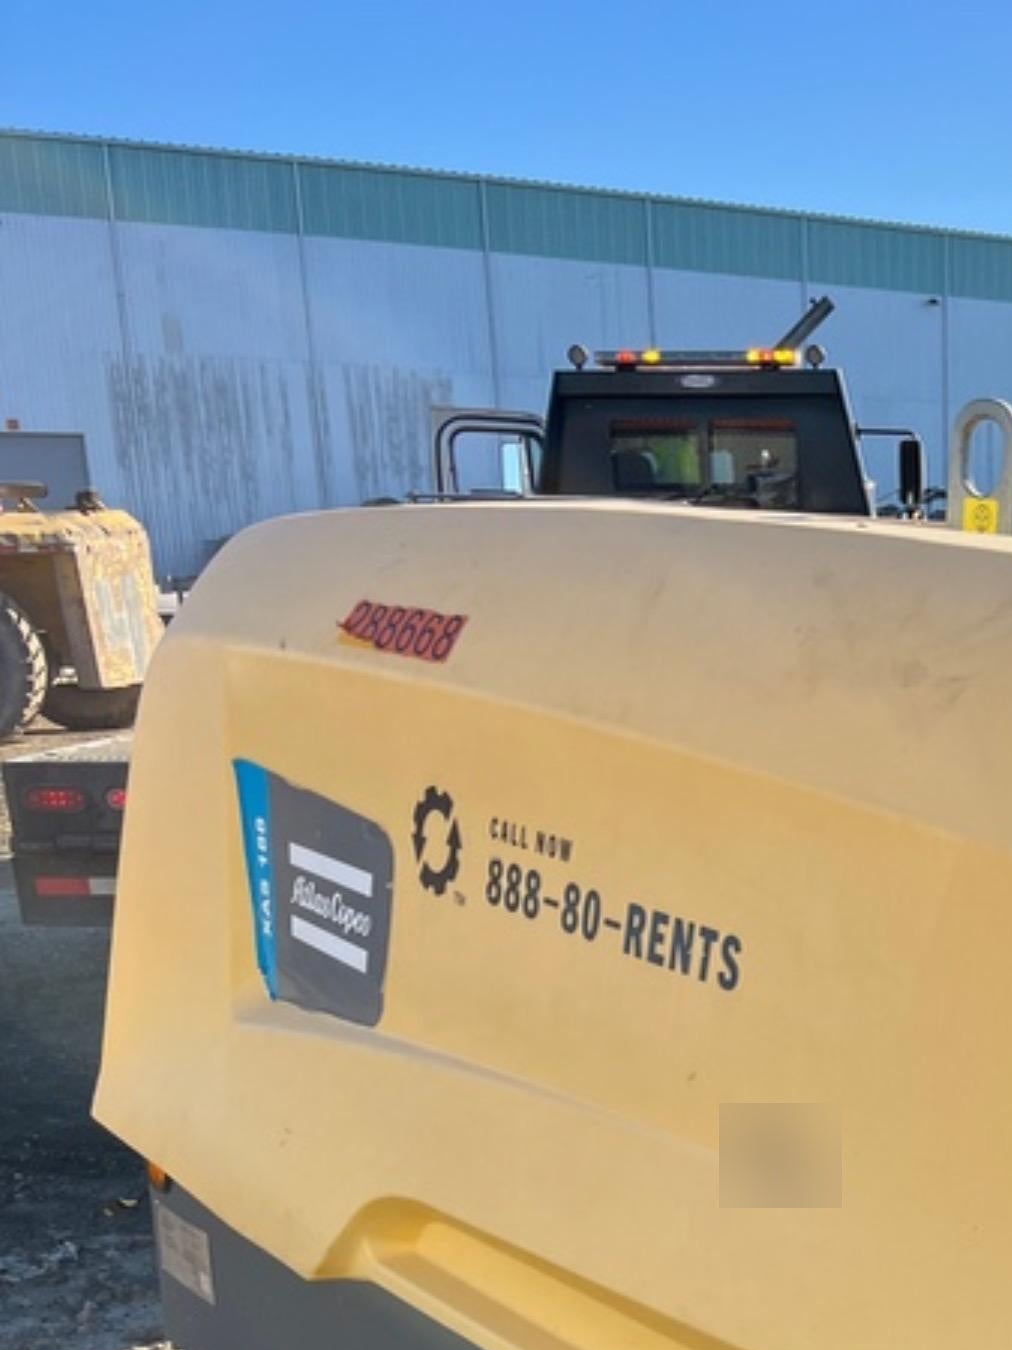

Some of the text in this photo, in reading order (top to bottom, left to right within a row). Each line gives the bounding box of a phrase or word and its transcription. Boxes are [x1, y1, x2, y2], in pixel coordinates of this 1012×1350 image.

[489, 816, 574, 863] CALL NOW
[485, 857, 743, 992] 888-80-RENTS
